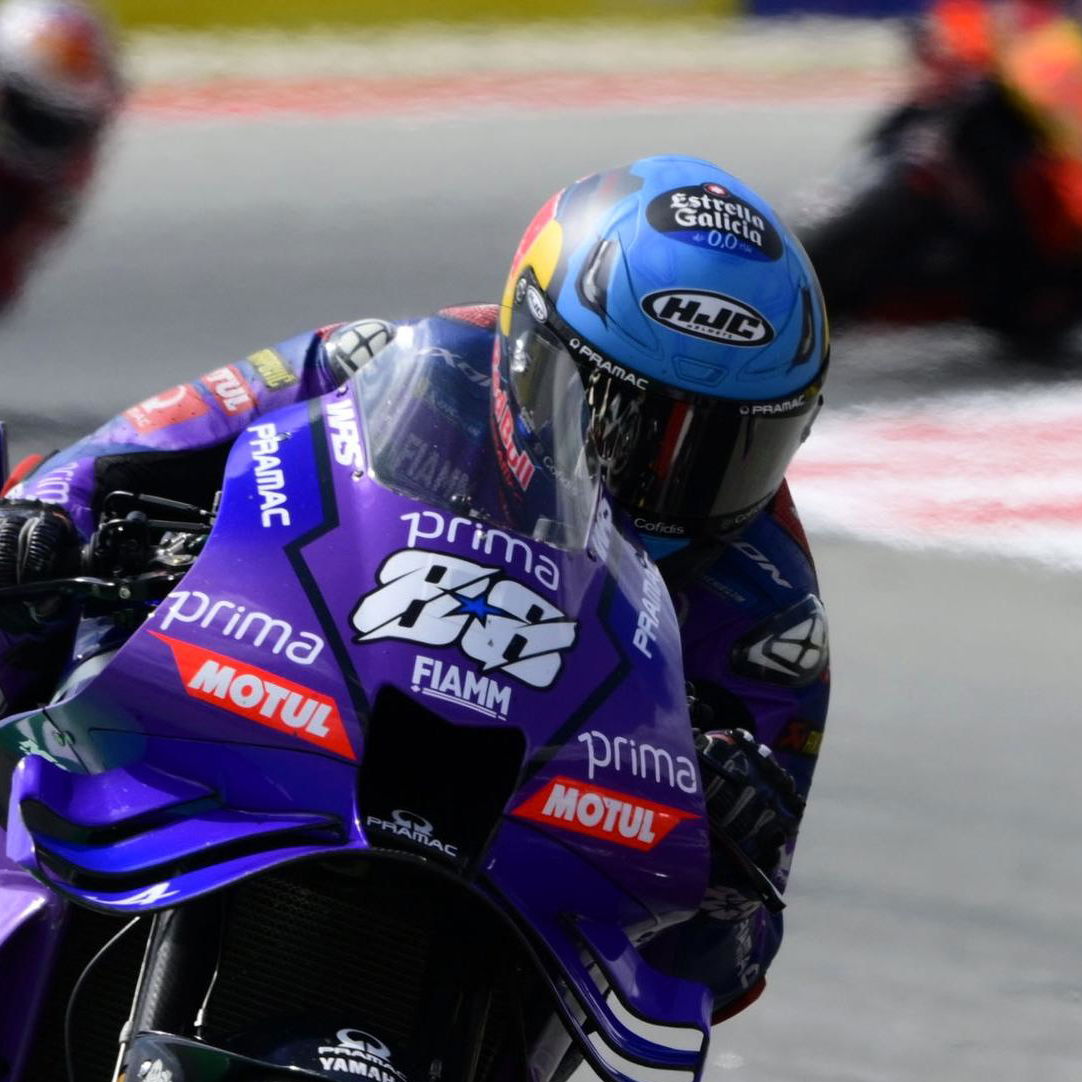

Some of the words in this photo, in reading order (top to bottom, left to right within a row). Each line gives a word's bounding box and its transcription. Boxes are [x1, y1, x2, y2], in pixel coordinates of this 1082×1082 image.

[670, 193, 765, 231] Estrella
[675, 207, 763, 247] Galicia
[659, 296, 761, 339] HJC
[578, 346, 650, 391] PRAMAC
[325, 398, 365, 472] WRS
[248, 422, 291, 528] PRAMAC
[400, 510, 560, 592] prima
[633, 517, 685, 535] Cofidis
[160, 591, 325, 665] prima
[350, 549, 578, 690] 88
[188, 659, 335, 740] MOTUL
[412, 655, 513, 716] FIAMM
[578, 731, 698, 794] prima
[367, 816, 458, 857] PRAMAC
[541, 783, 656, 844] MOTUL
